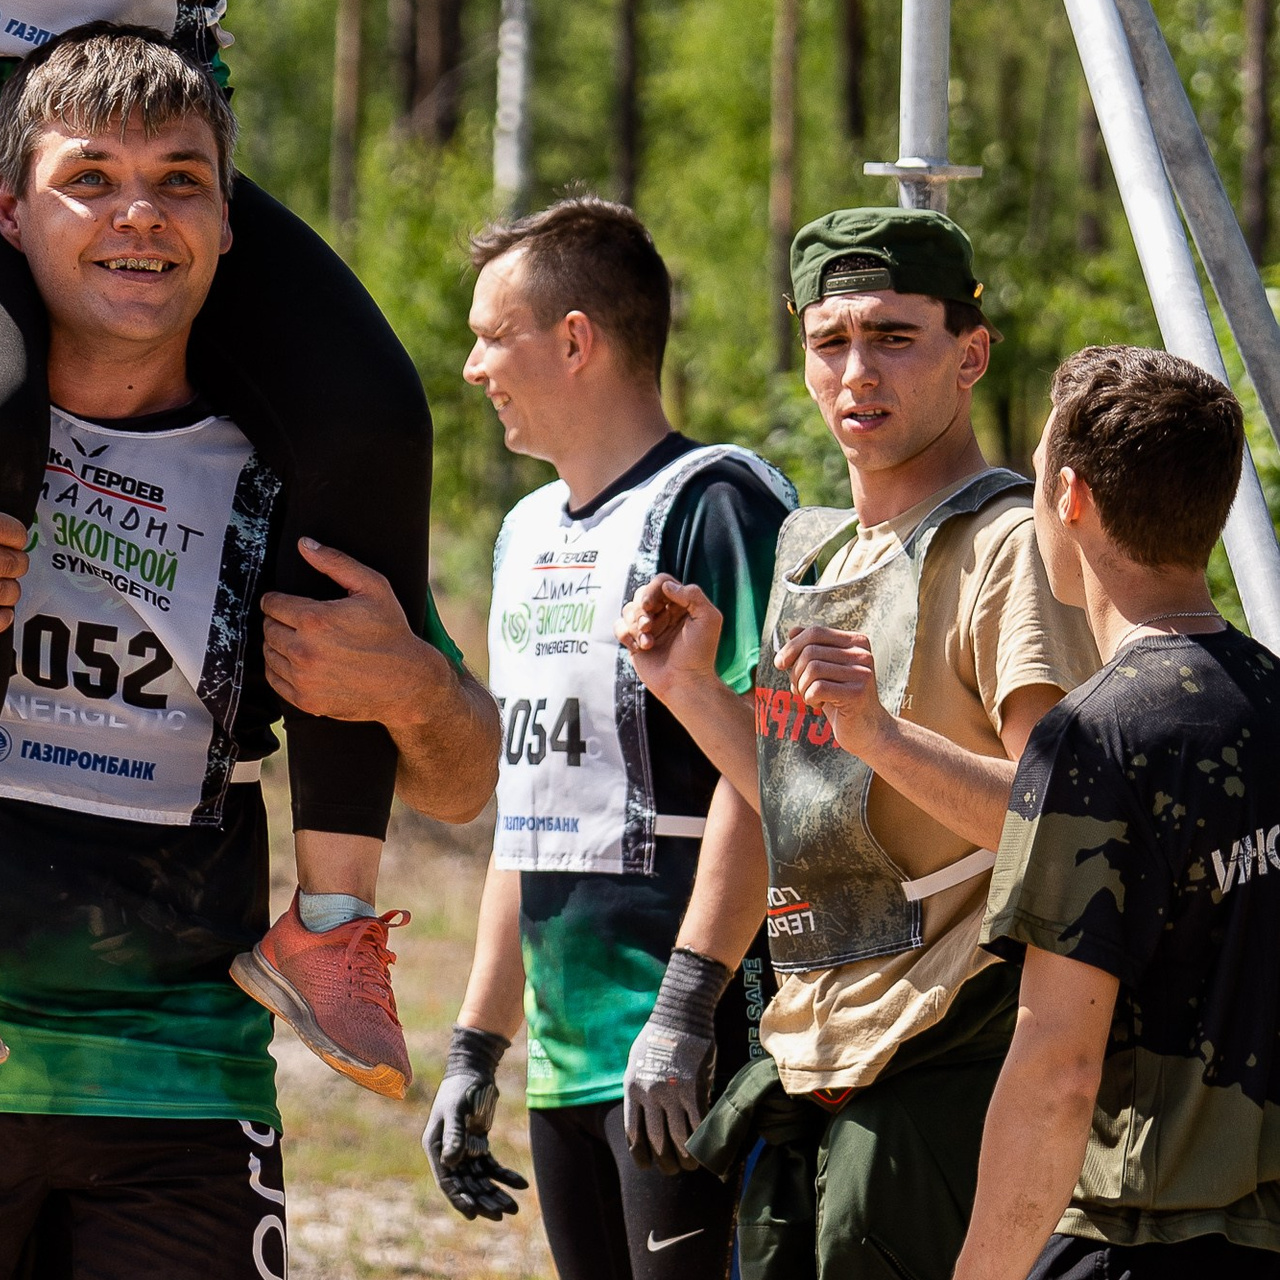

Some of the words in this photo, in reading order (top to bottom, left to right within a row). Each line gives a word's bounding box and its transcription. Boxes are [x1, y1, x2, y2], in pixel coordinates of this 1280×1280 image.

[4, 18, 58, 46] ГАЗП
[80, 463, 165, 504] ГЕРОЕВ
[52, 511, 180, 593] ЭКОГЕРОЙ
[51, 552, 172, 613] SYNERGETIC
[13, 613, 174, 710] 052
[535, 639, 589, 657] SYNERGETIC
[20, 739, 157, 782] ГАЗПРОМБАНК
[742, 956, 765, 1021] SAFE
